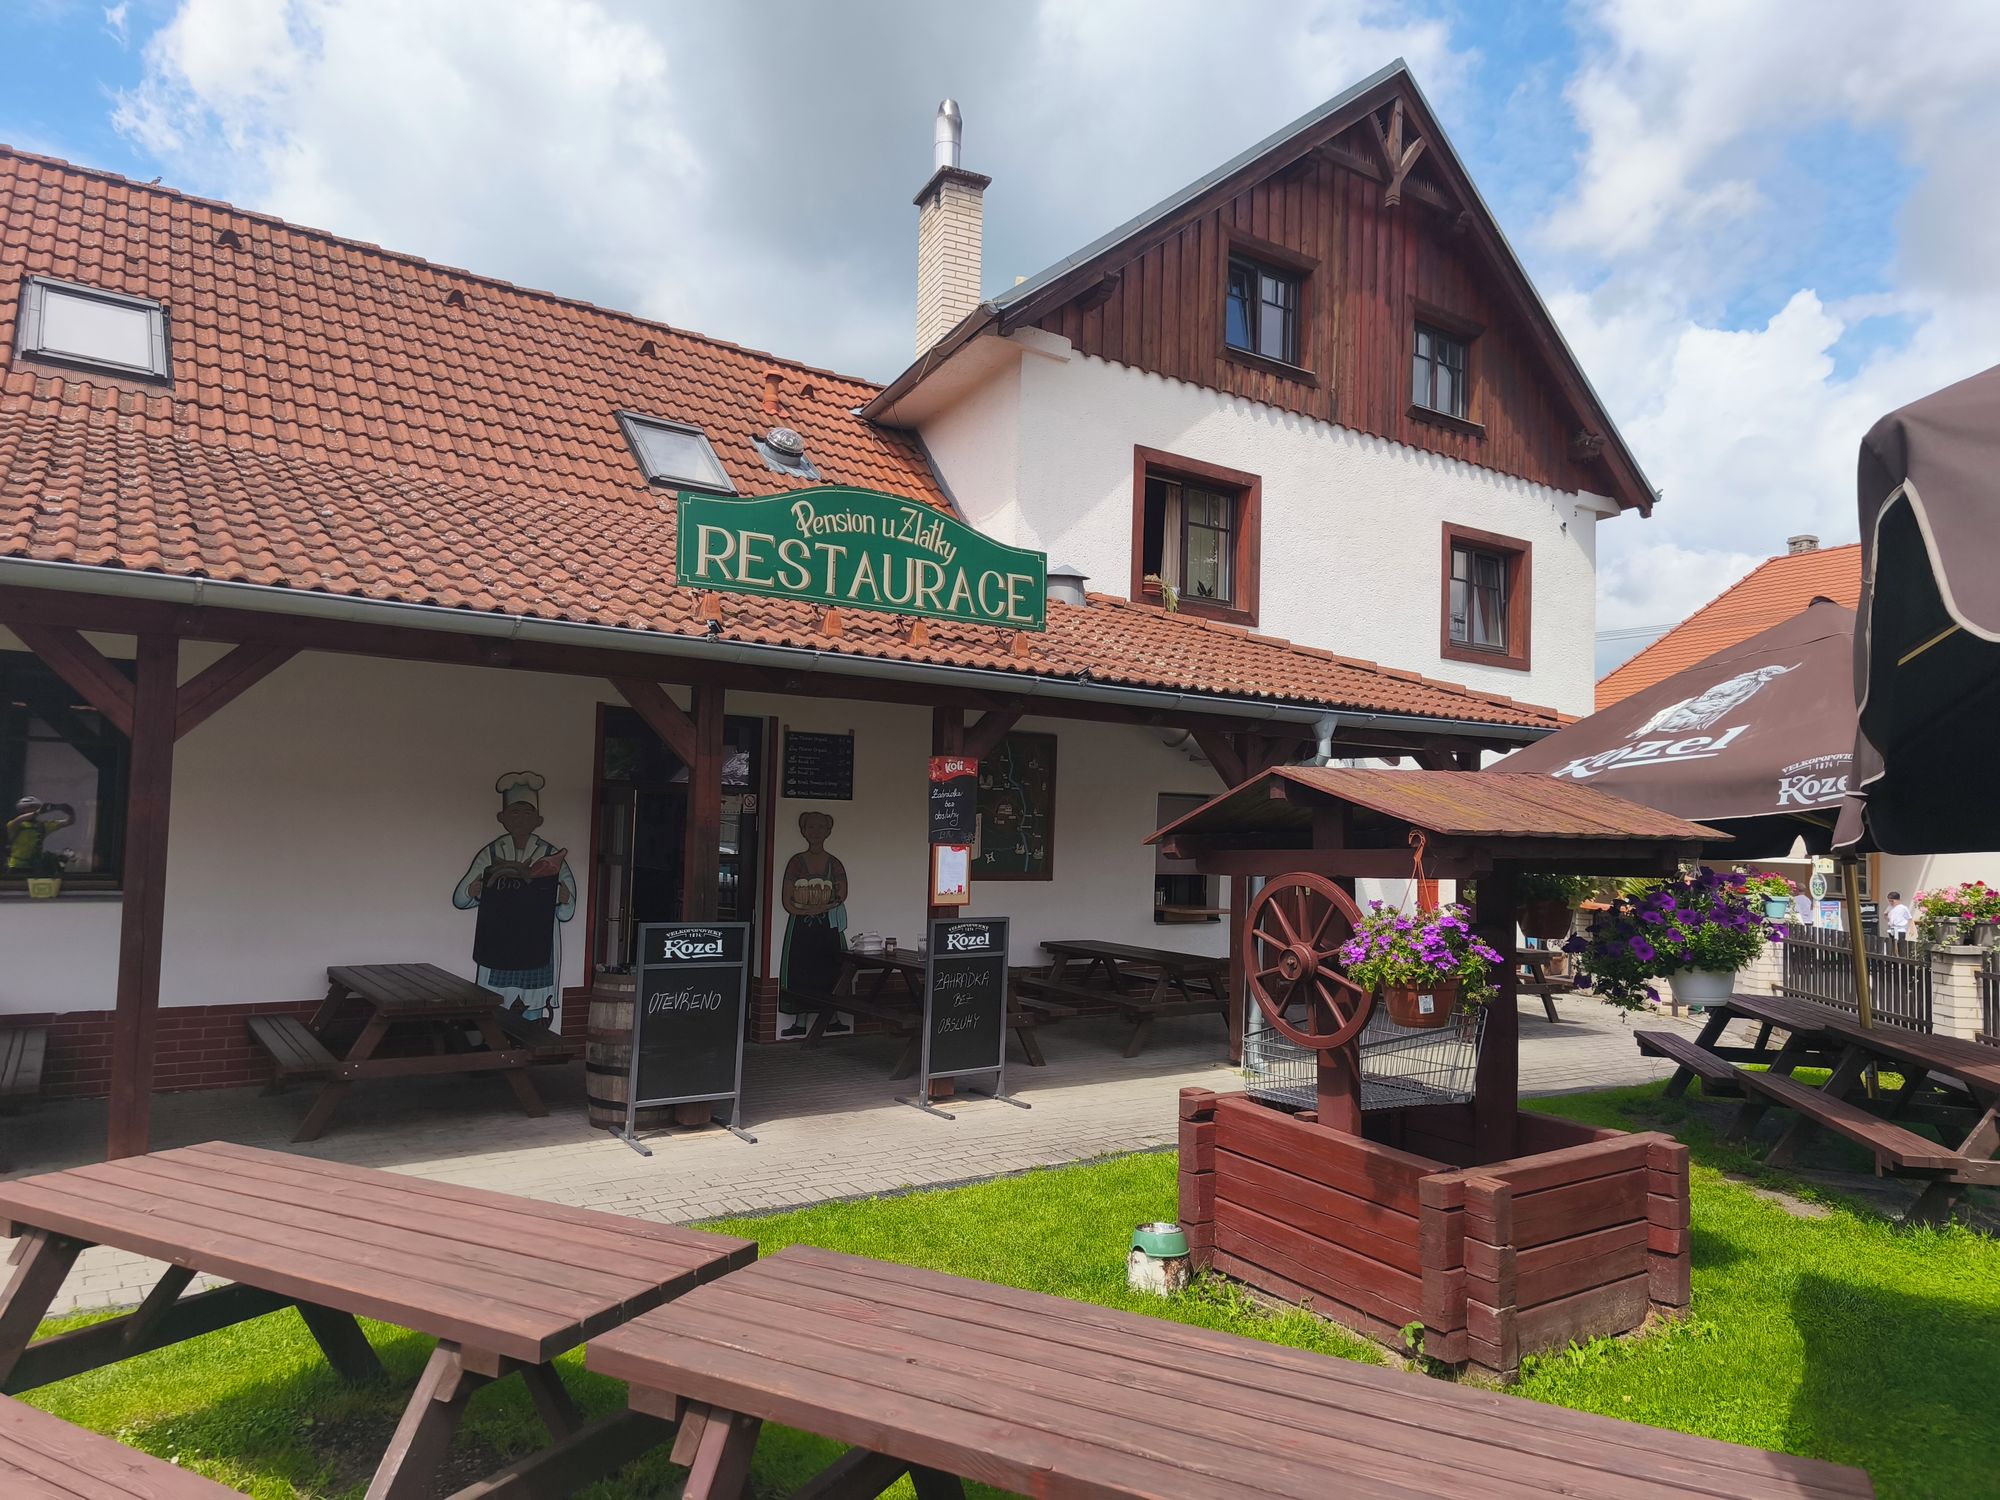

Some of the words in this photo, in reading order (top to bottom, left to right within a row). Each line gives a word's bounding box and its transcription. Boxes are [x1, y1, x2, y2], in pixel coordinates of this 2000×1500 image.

[790, 500, 876, 539] Pension
[882, 517, 896, 539] u
[897, 505, 959, 567] Zlatky
[694, 523, 1035, 623] RESTAURACE
[1550, 723, 1752, 780] Kozel
[1781, 753, 1854, 774] VELKOPOPOVIC
[1815, 761, 1833, 770] 1874
[1776, 774, 1849, 806] Koze
[663, 938, 724, 960] Kozel
[946, 932, 991, 950] Kozel
[648, 985, 722, 1014] OTEVŘENO
[938, 1013, 980, 1034] OBSLUHY
